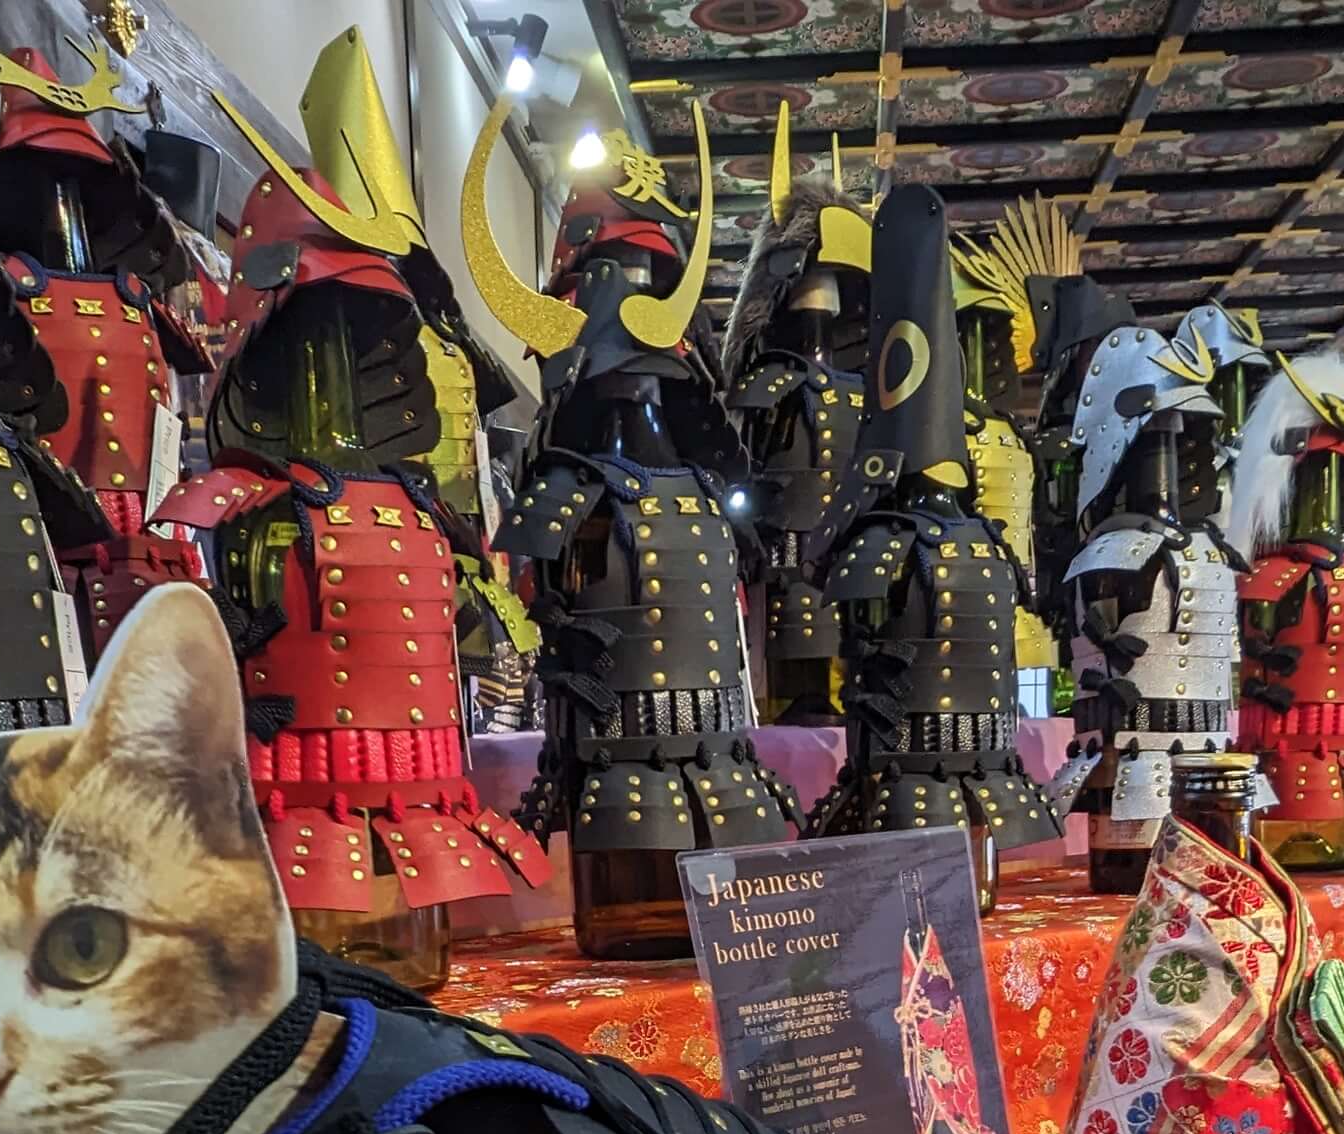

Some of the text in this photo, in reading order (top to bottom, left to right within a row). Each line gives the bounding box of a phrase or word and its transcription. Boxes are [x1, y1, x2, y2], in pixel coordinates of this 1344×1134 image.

[707, 867, 825, 907] Japanese
[729, 906, 816, 934] kimono
[713, 928, 841, 965] bottle cover
